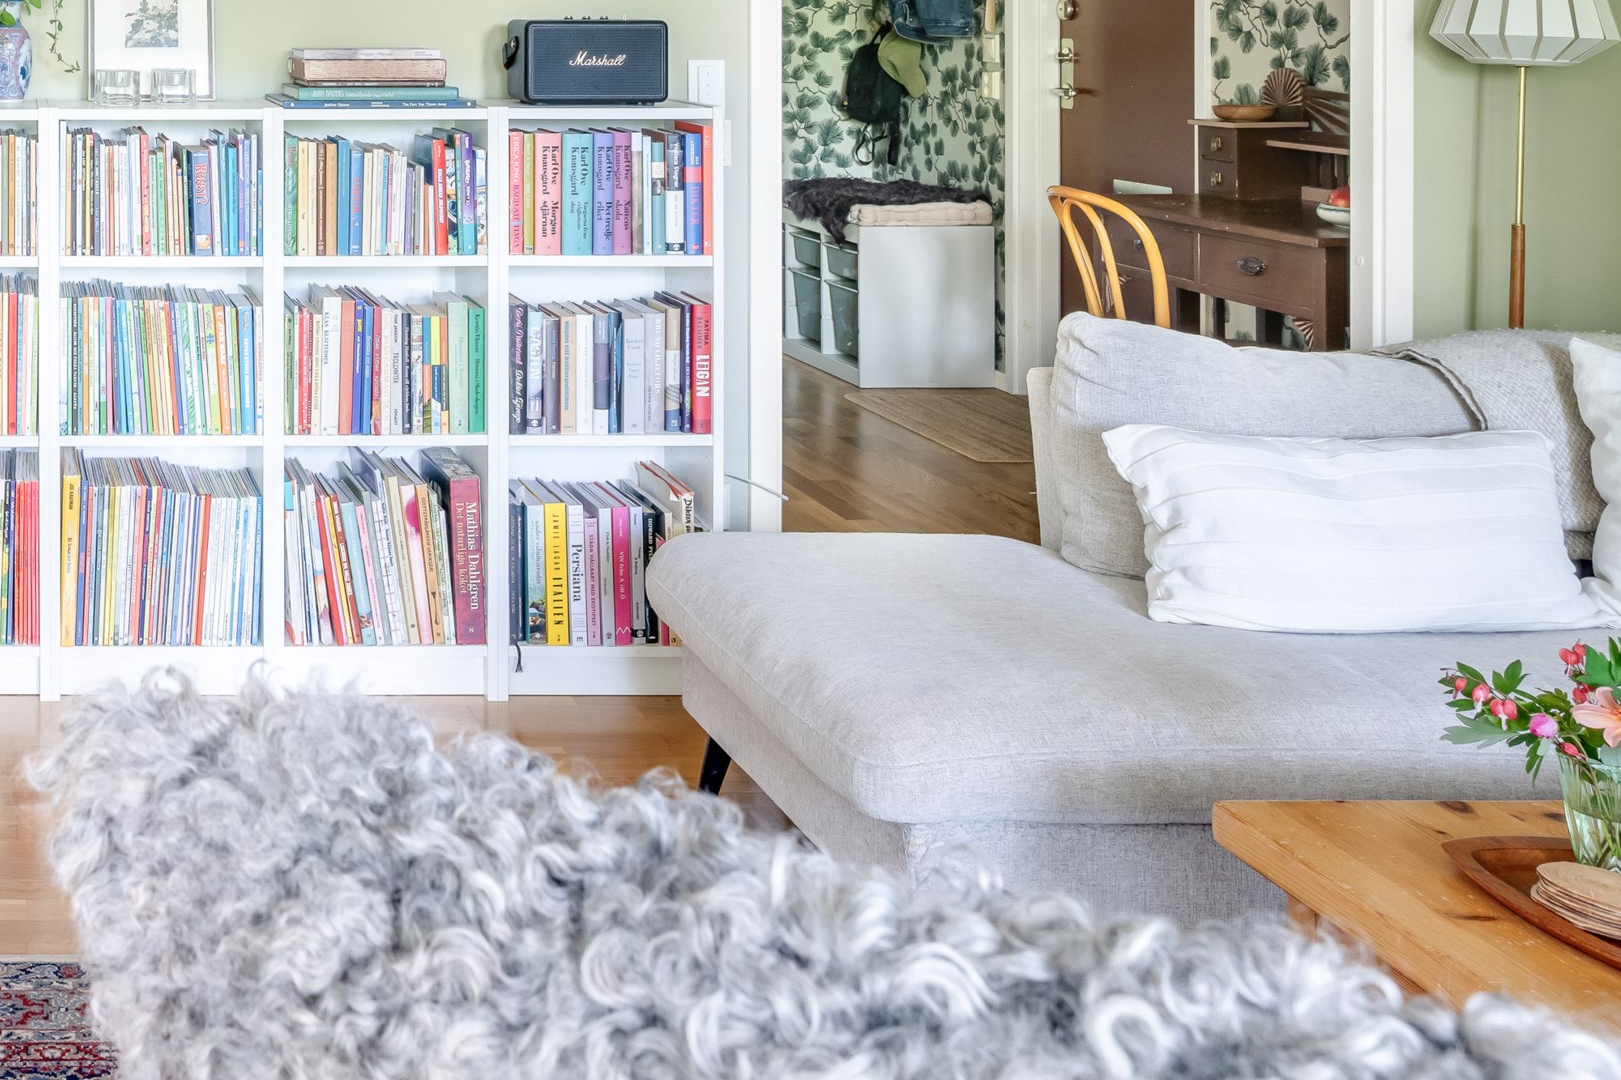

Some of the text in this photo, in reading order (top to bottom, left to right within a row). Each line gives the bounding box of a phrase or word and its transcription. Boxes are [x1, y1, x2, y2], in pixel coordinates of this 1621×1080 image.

[568, 51, 626, 66] Marshall
[194, 164, 208, 205] KONST?
[551, 145, 560, 185] Karl Ove
[541, 200, 550, 237] stjärnan
[551, 200, 559, 235] Morgon
[455, 502, 468, 594] Det naturliga köket
[465, 501, 480, 610] Mathias Dahlgren
[571, 544, 584, 602] Persiana
[553, 577, 563, 625] ITALIEN
